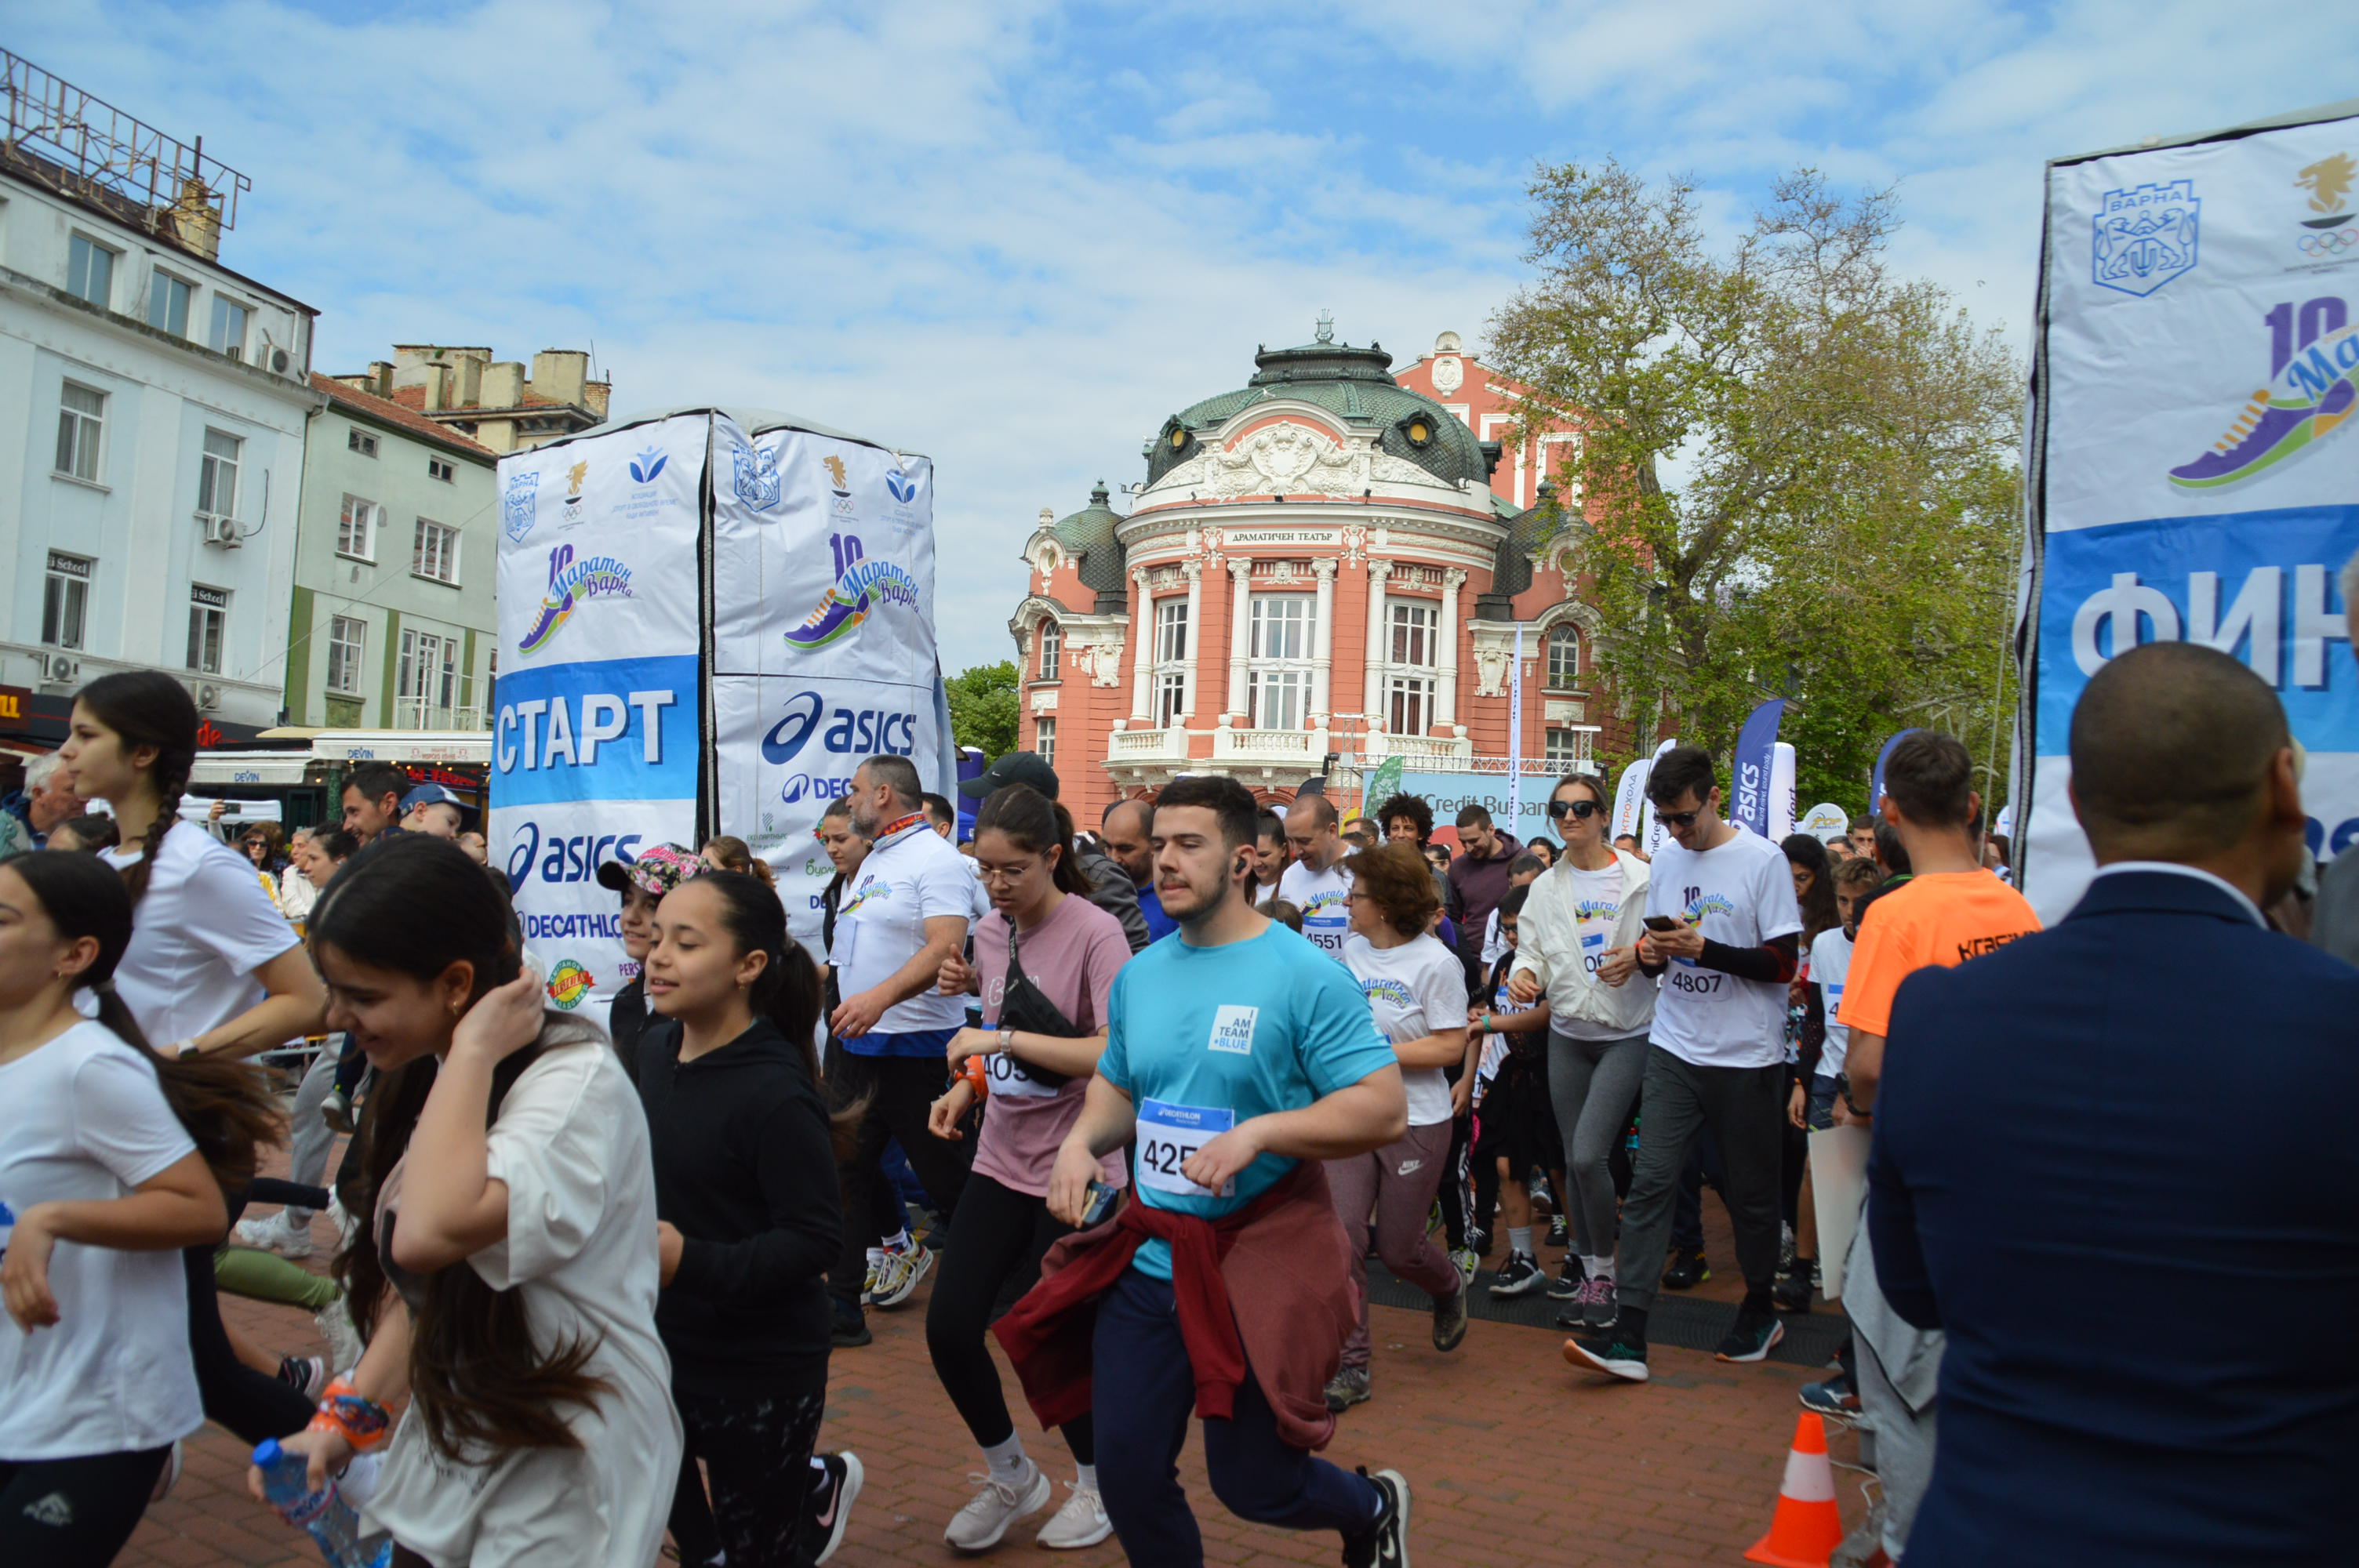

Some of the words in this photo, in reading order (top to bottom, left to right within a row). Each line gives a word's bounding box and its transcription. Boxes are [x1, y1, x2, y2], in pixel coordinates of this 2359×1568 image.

[2110, 190, 2184, 212] ВАРНА
[2287, 333, 2359, 401] Ма
[1232, 533, 1294, 542] ДРАМАТИЧЕН
[56, 557, 87, 575] School
[552, 556, 632, 602] Маратон
[583, 574, 633, 597] Варна
[842, 561, 919, 604] Маратон
[198, 590, 224, 604] School
[878, 578, 919, 614] Варна
[2072, 563, 2350, 691] ФИН
[496, 690, 677, 775] СТАРТ
[347, 747, 374, 760] DEVIN
[234, 769, 260, 782] DEVIN
[1761, 770, 1769, 789] sound
[1410, 793, 1478, 814] Credit
[1620, 774, 1637, 835] КТРОХОЛД
[1310, 889, 1347, 905] Marath
[1579, 898, 1619, 913] Marat
[1688, 893, 1734, 916] Marathon
[1707, 905, 1731, 917] Varna
[527, 913, 623, 939] DECATHLO
[1361, 977, 1411, 1004] Marathon
[1672, 971, 1722, 993] 4807
[1381, 989, 1407, 1010] Varna
[1233, 1018, 1251, 1029] AM
[1249, 1010, 1254, 1019] I
[1219, 1026, 1249, 1039] TEAM
[1164, 1108, 1201, 1121] DECATHLON
[1143, 1139, 1198, 1176] 425
[1401, 1160, 1420, 1168] NIKE
